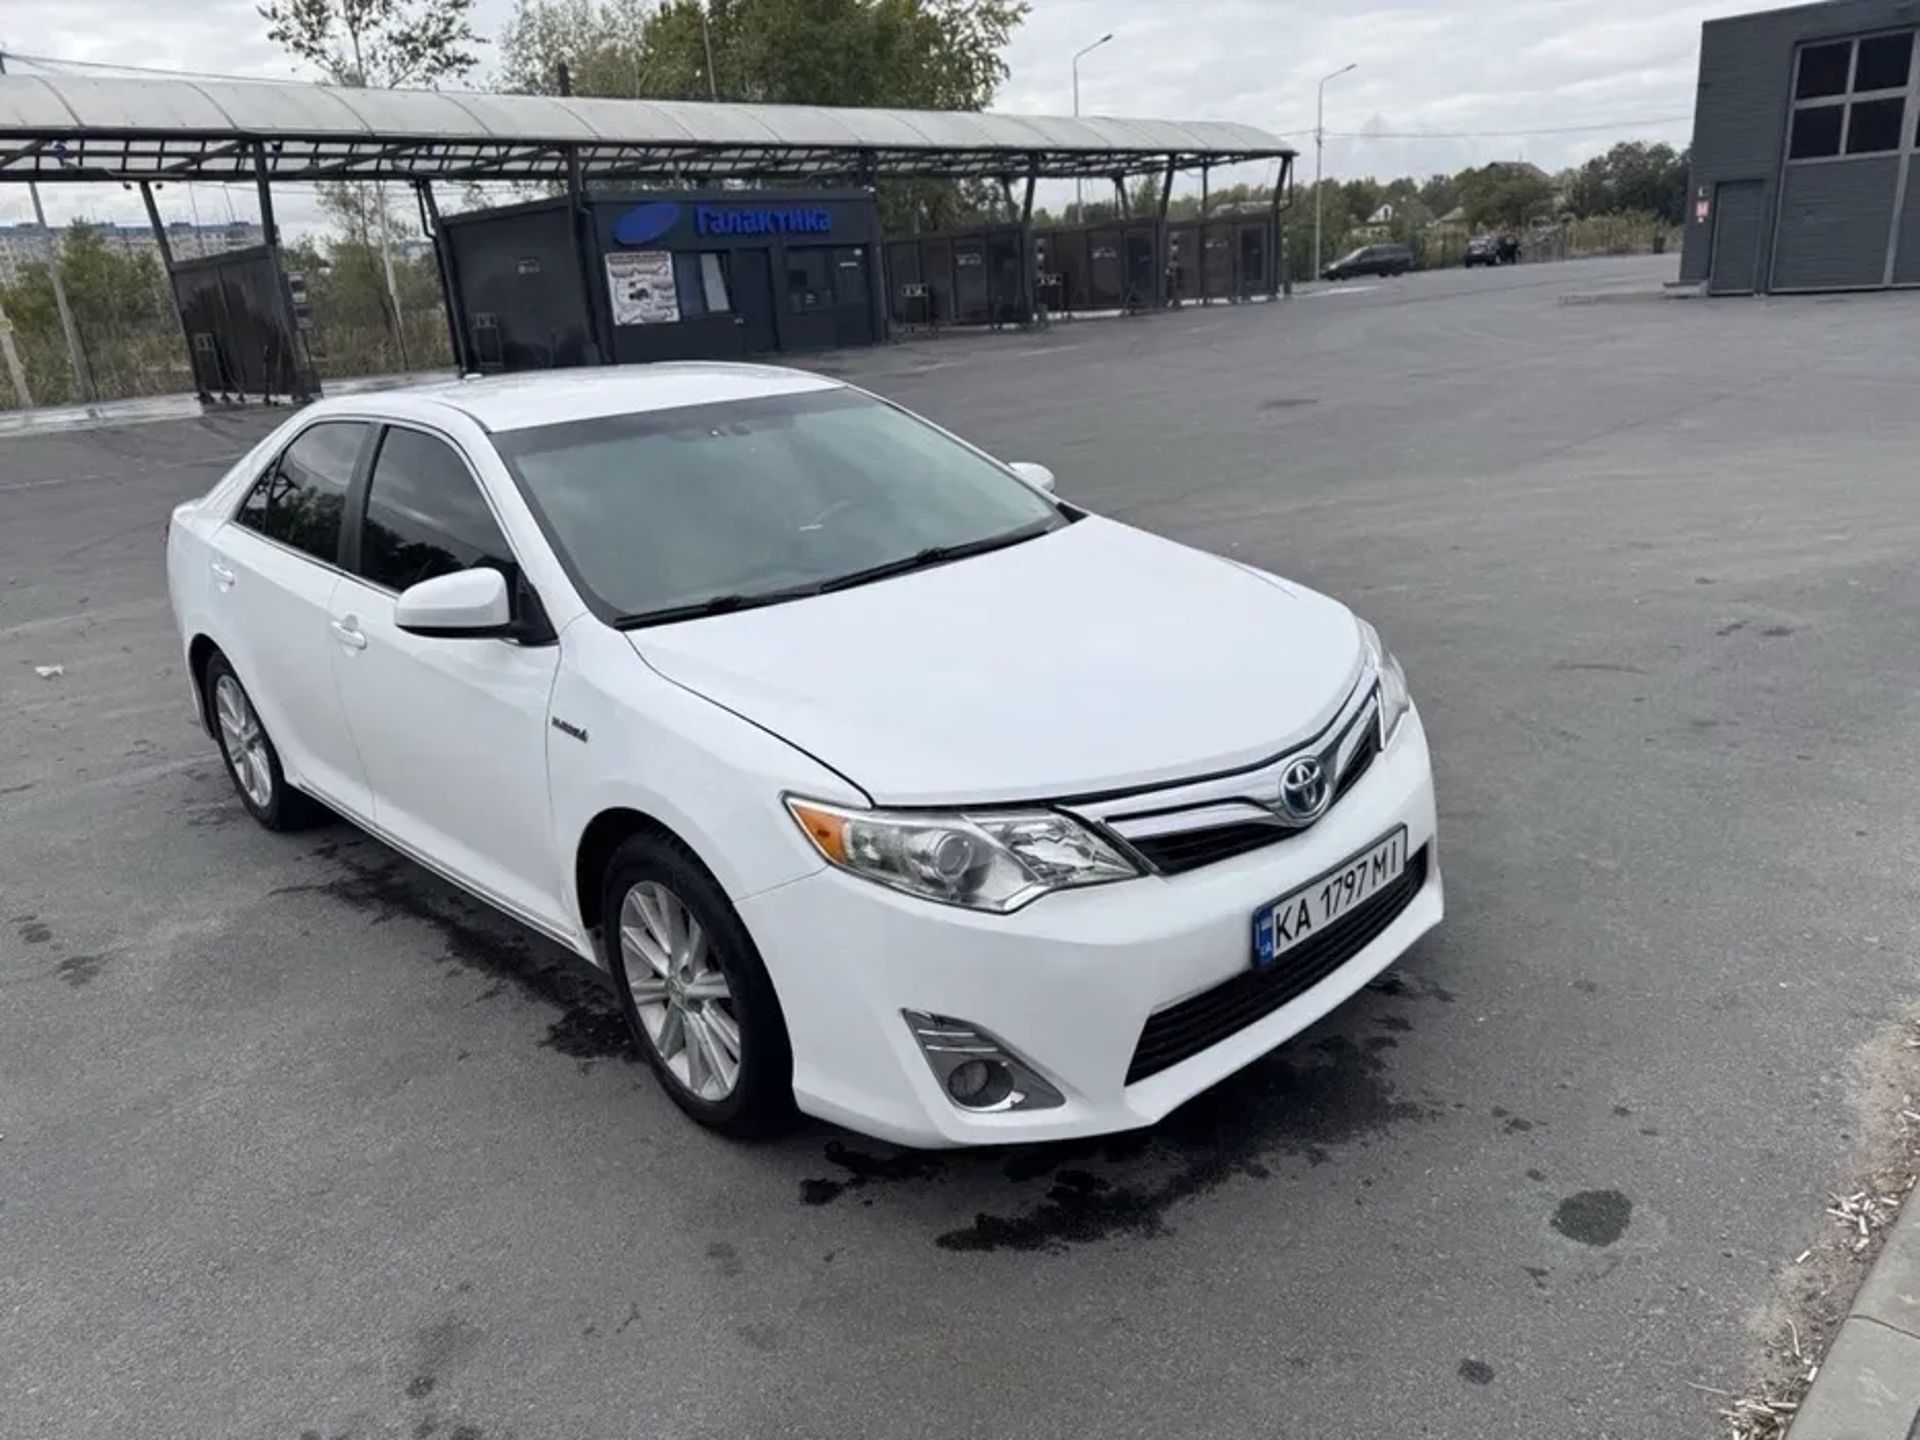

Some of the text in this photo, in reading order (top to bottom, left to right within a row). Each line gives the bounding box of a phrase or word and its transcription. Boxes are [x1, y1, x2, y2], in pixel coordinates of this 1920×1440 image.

[696, 206, 832, 233] Галактика
[1276, 841, 1396, 948] KA 1797 MI
